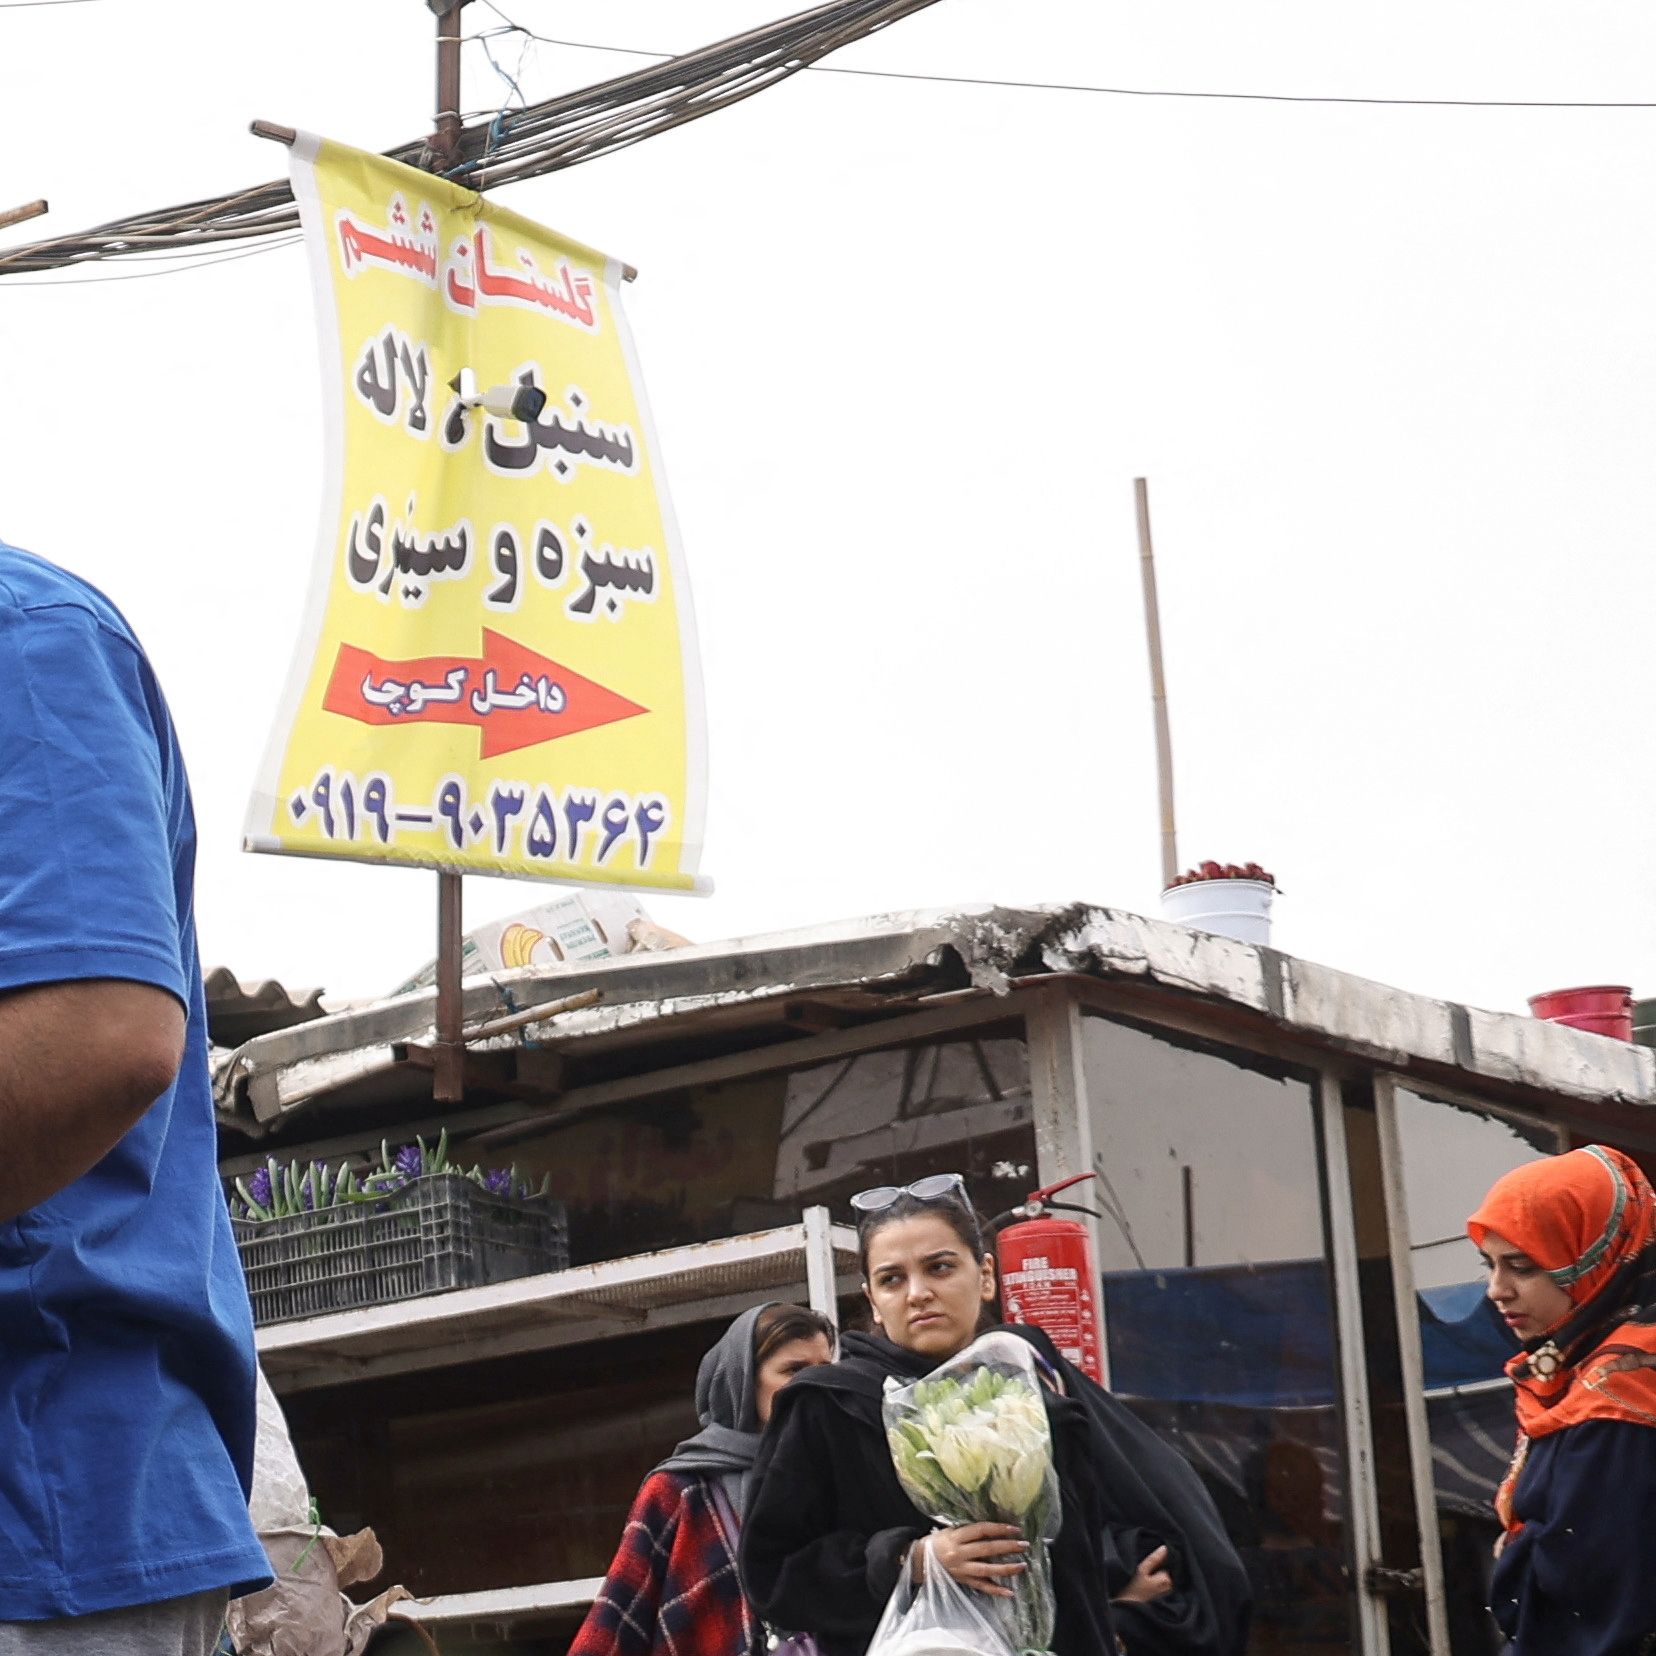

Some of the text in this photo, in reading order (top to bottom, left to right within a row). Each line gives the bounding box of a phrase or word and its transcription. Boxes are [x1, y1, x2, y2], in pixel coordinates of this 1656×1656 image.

[339, 200, 594, 326] گلستان ششم
[356, 332, 429, 431] لاله
[485, 368, 633, 475] سنبل
[488, 530, 517, 604] و
[538, 522, 653, 614] سبزه
[471, 667, 566, 715] داخل
[1021, 1256, 1049, 1271] FIRE
